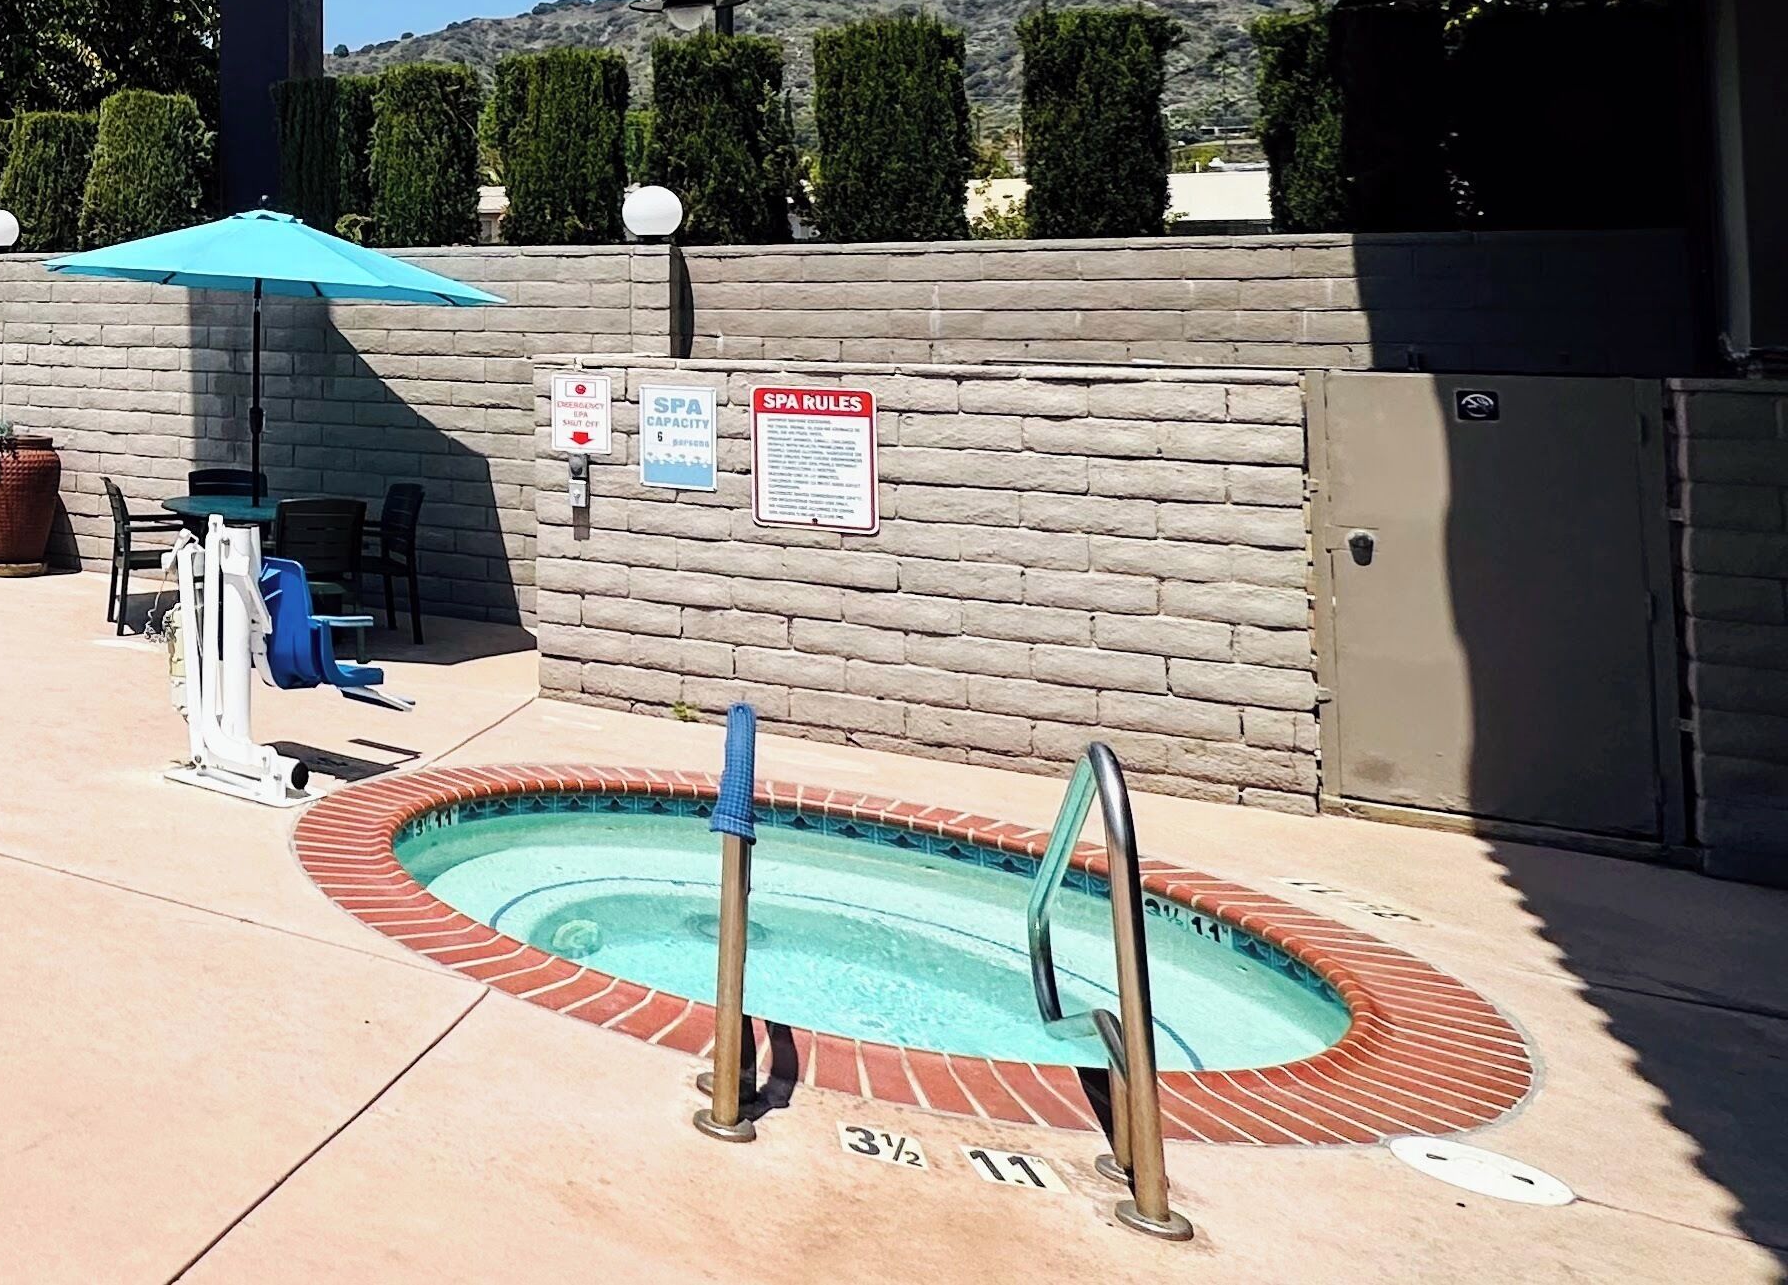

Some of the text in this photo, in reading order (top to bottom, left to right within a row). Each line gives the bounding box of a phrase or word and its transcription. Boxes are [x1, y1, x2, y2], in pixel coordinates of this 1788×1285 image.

[653, 396, 703, 415] SPA
[763, 393, 863, 412] SPA RULES
[647, 416, 710, 430] CAPACITY
[672, 439, 710, 449] persons
